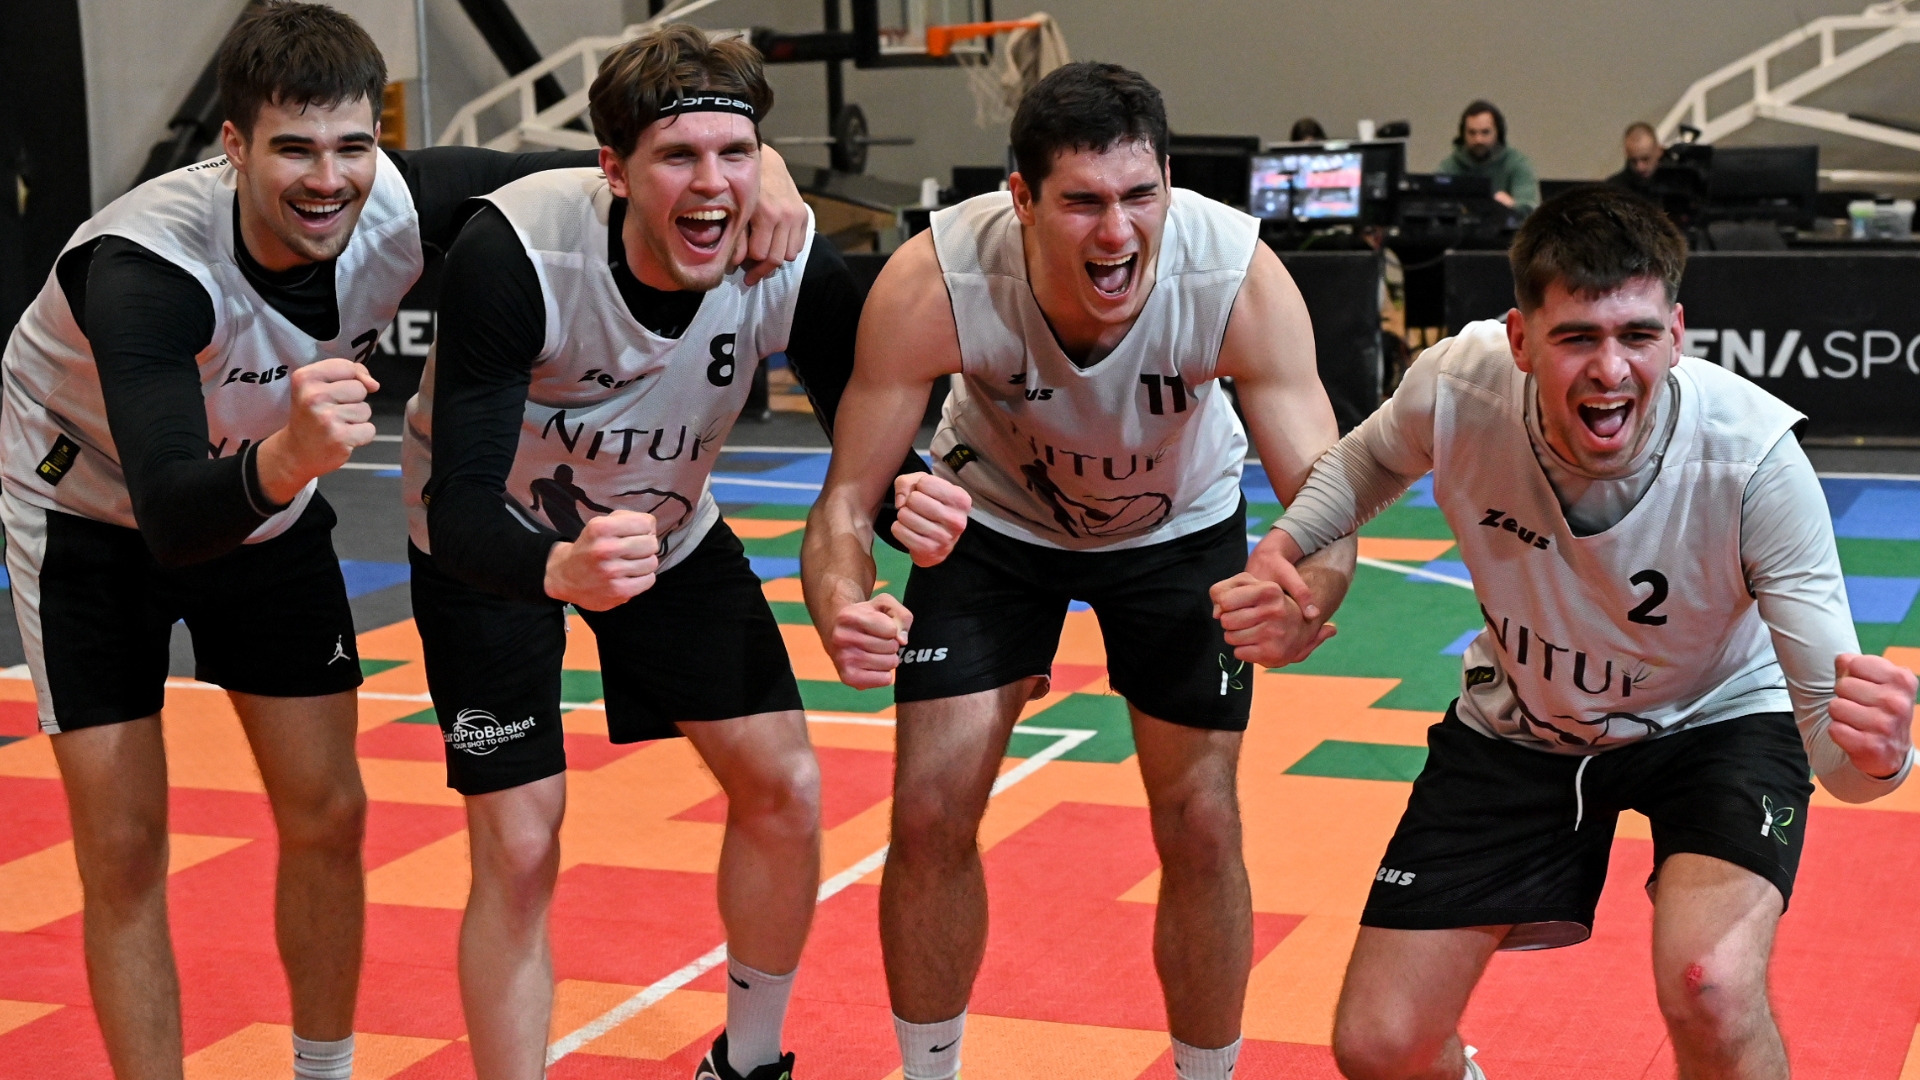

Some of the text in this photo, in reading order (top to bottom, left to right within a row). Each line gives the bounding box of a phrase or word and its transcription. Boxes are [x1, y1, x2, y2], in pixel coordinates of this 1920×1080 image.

[221, 364, 289, 387] Zeus
[707, 333, 736, 387] 8
[1140, 373, 1187, 415] 11
[1478, 508, 1550, 550] Zeus
[1628, 569, 1669, 626] 2
[467, 739, 485, 748] SHOT
[497, 736, 509, 744] GO
[510, 732, 525, 740] PRO
